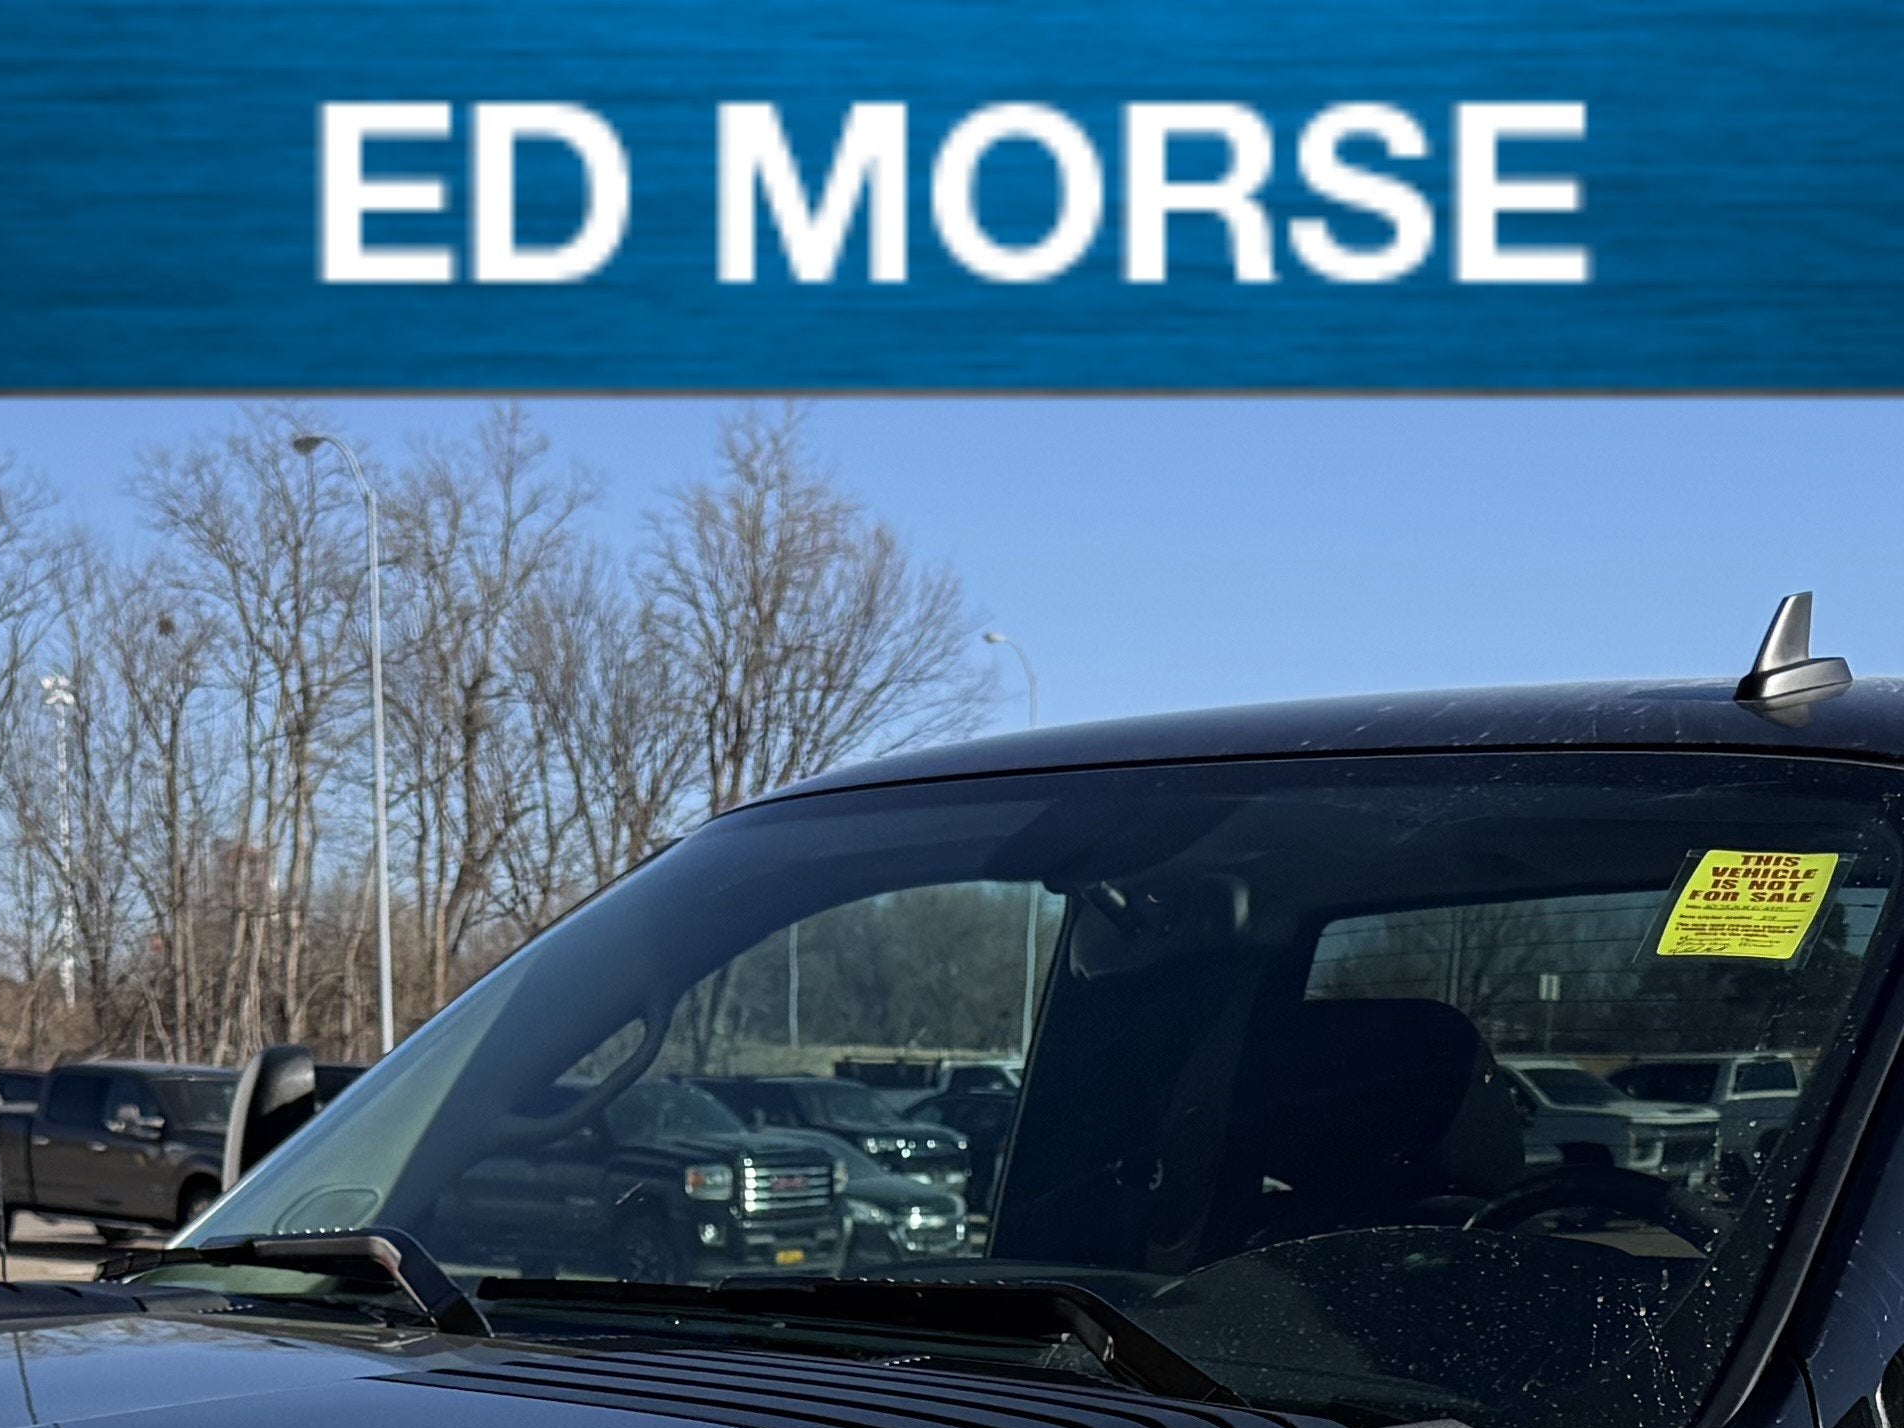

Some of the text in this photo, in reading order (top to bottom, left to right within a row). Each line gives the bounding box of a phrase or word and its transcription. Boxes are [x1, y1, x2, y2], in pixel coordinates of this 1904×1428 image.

[1741, 854, 1802, 867] THIS
[1711, 866, 1819, 880] VEHICLE
[1711, 879, 1805, 891] IS NOT
[1688, 890, 1815, 903] FOR SALE
